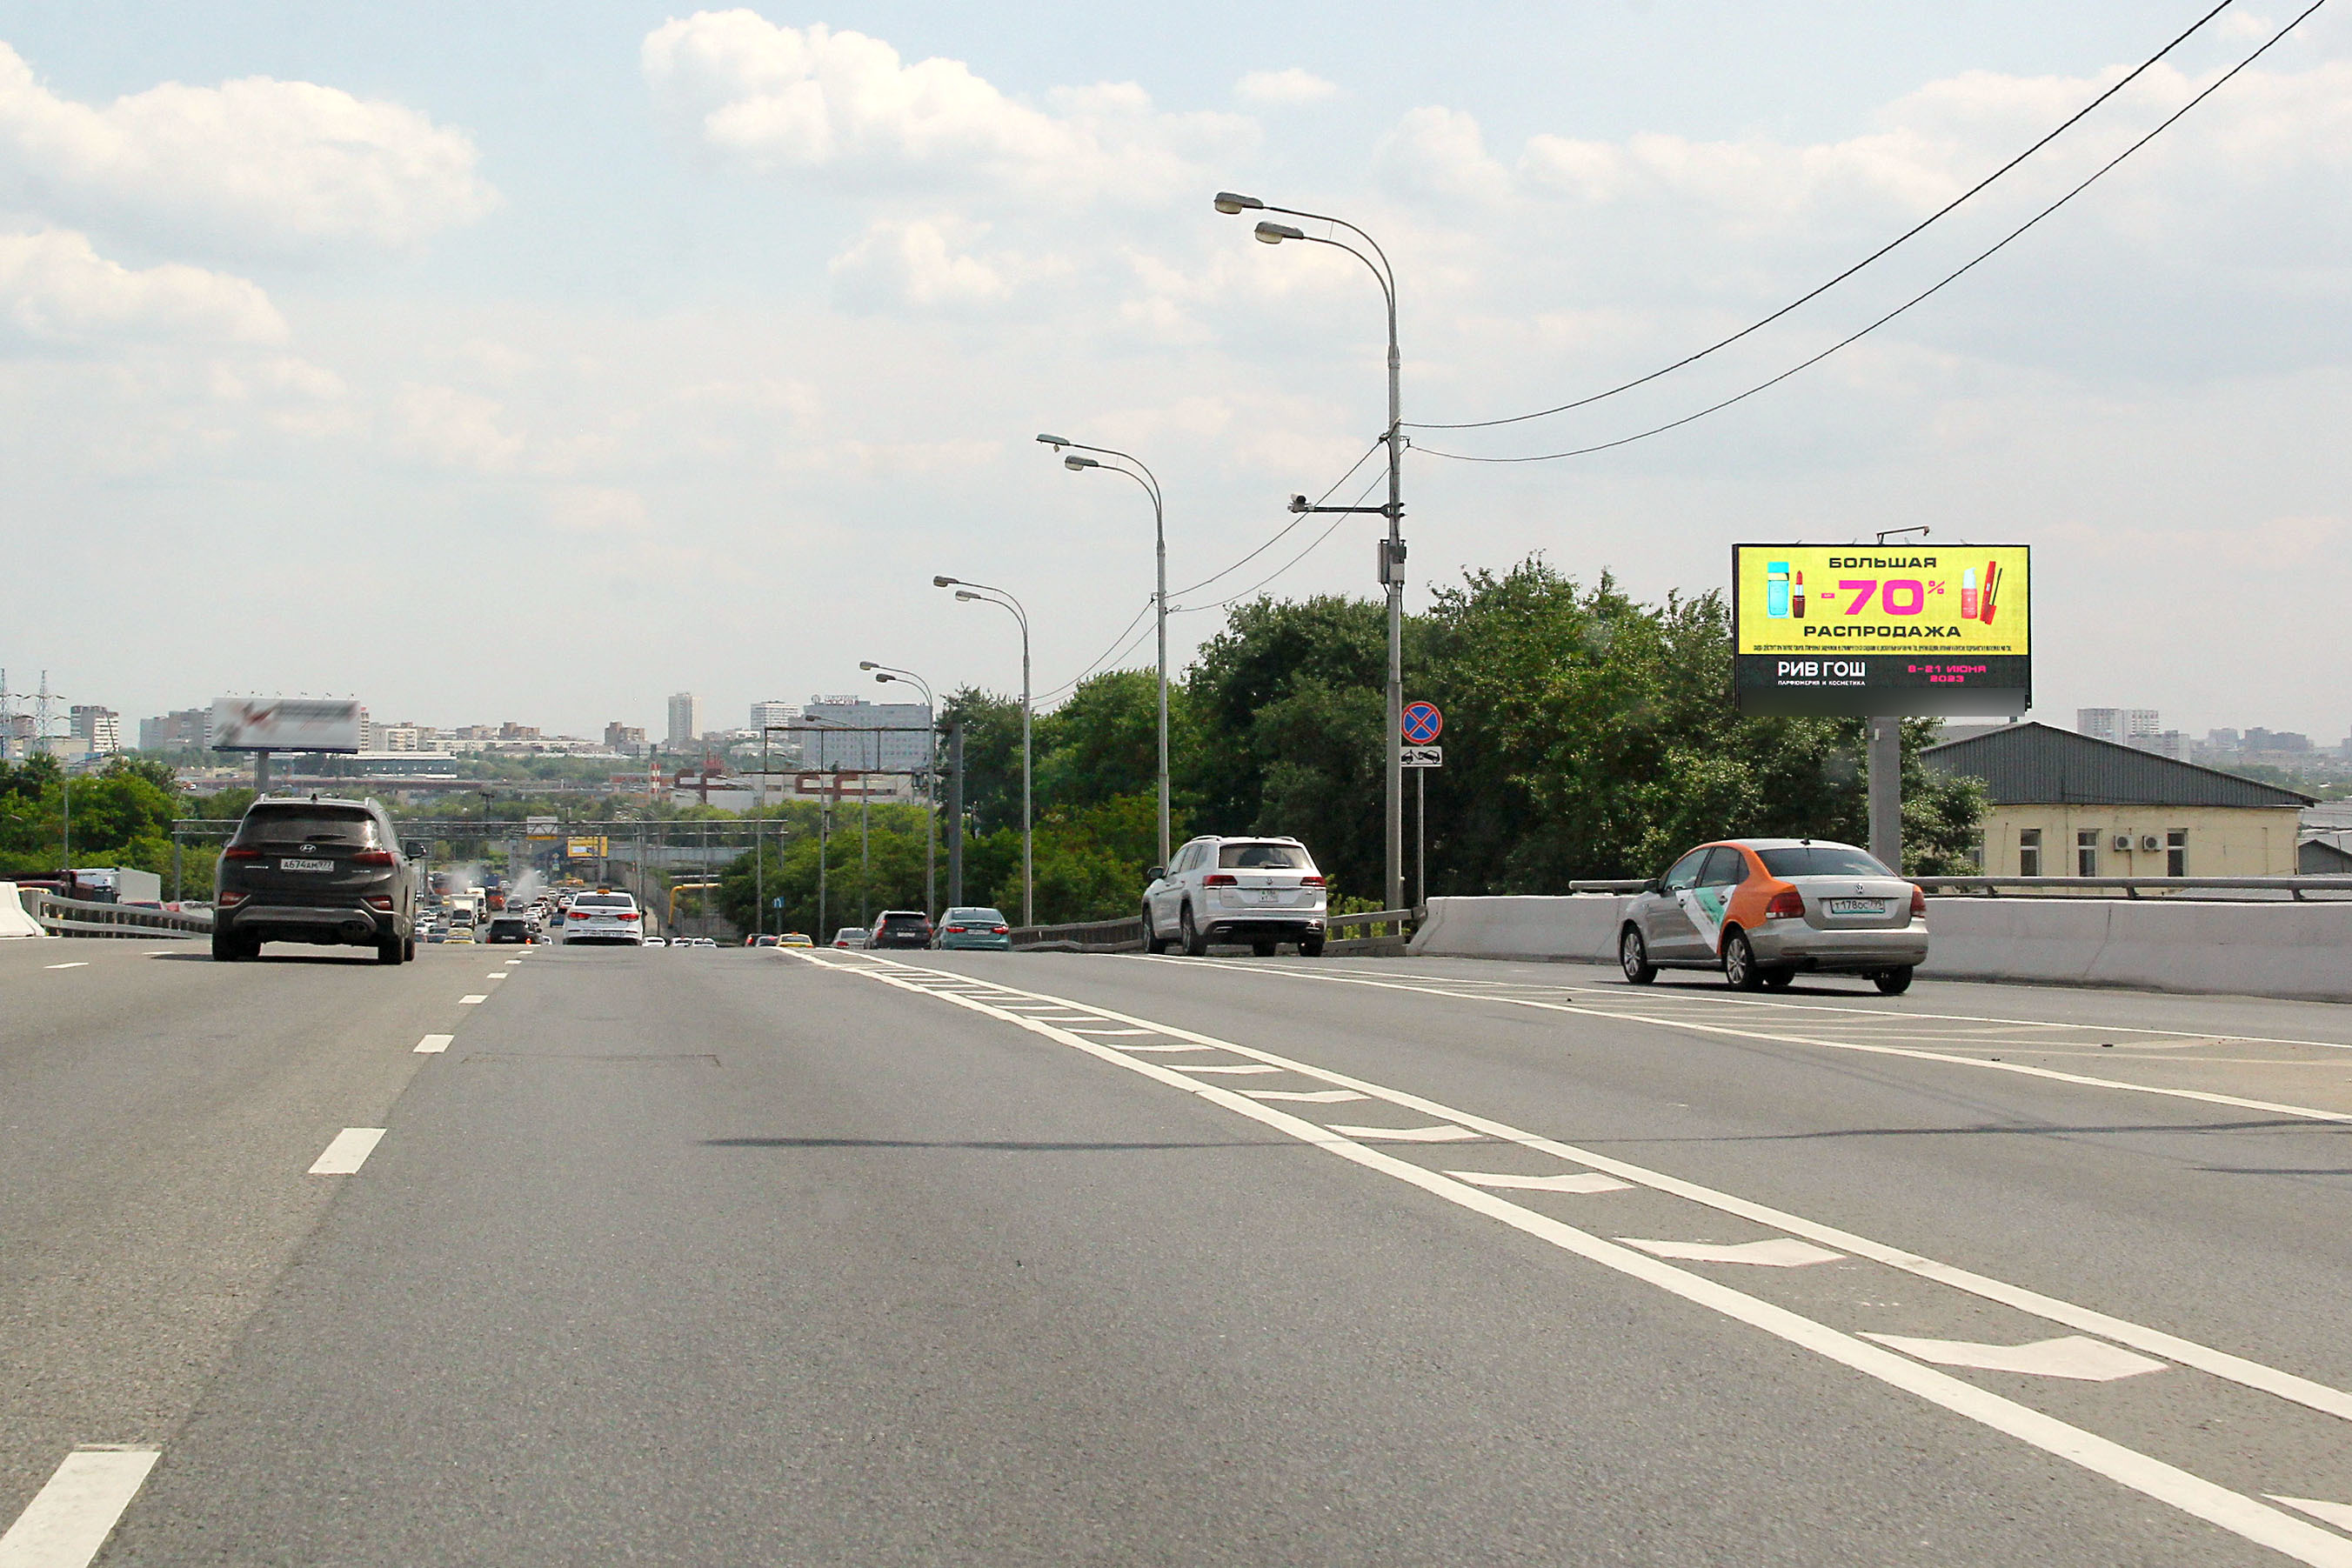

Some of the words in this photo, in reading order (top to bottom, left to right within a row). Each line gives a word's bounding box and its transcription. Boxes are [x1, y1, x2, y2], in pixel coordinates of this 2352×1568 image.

[1829, 557, 1937, 568] БОЛЬШАЯ
[1804, 625, 1961, 637] РАСПРОДАЖА
[1778, 661, 1819, 677] РИВ
[1823, 661, 1866, 677] ГОШ
[1946, 664, 1987, 673] ИЮНЯ
